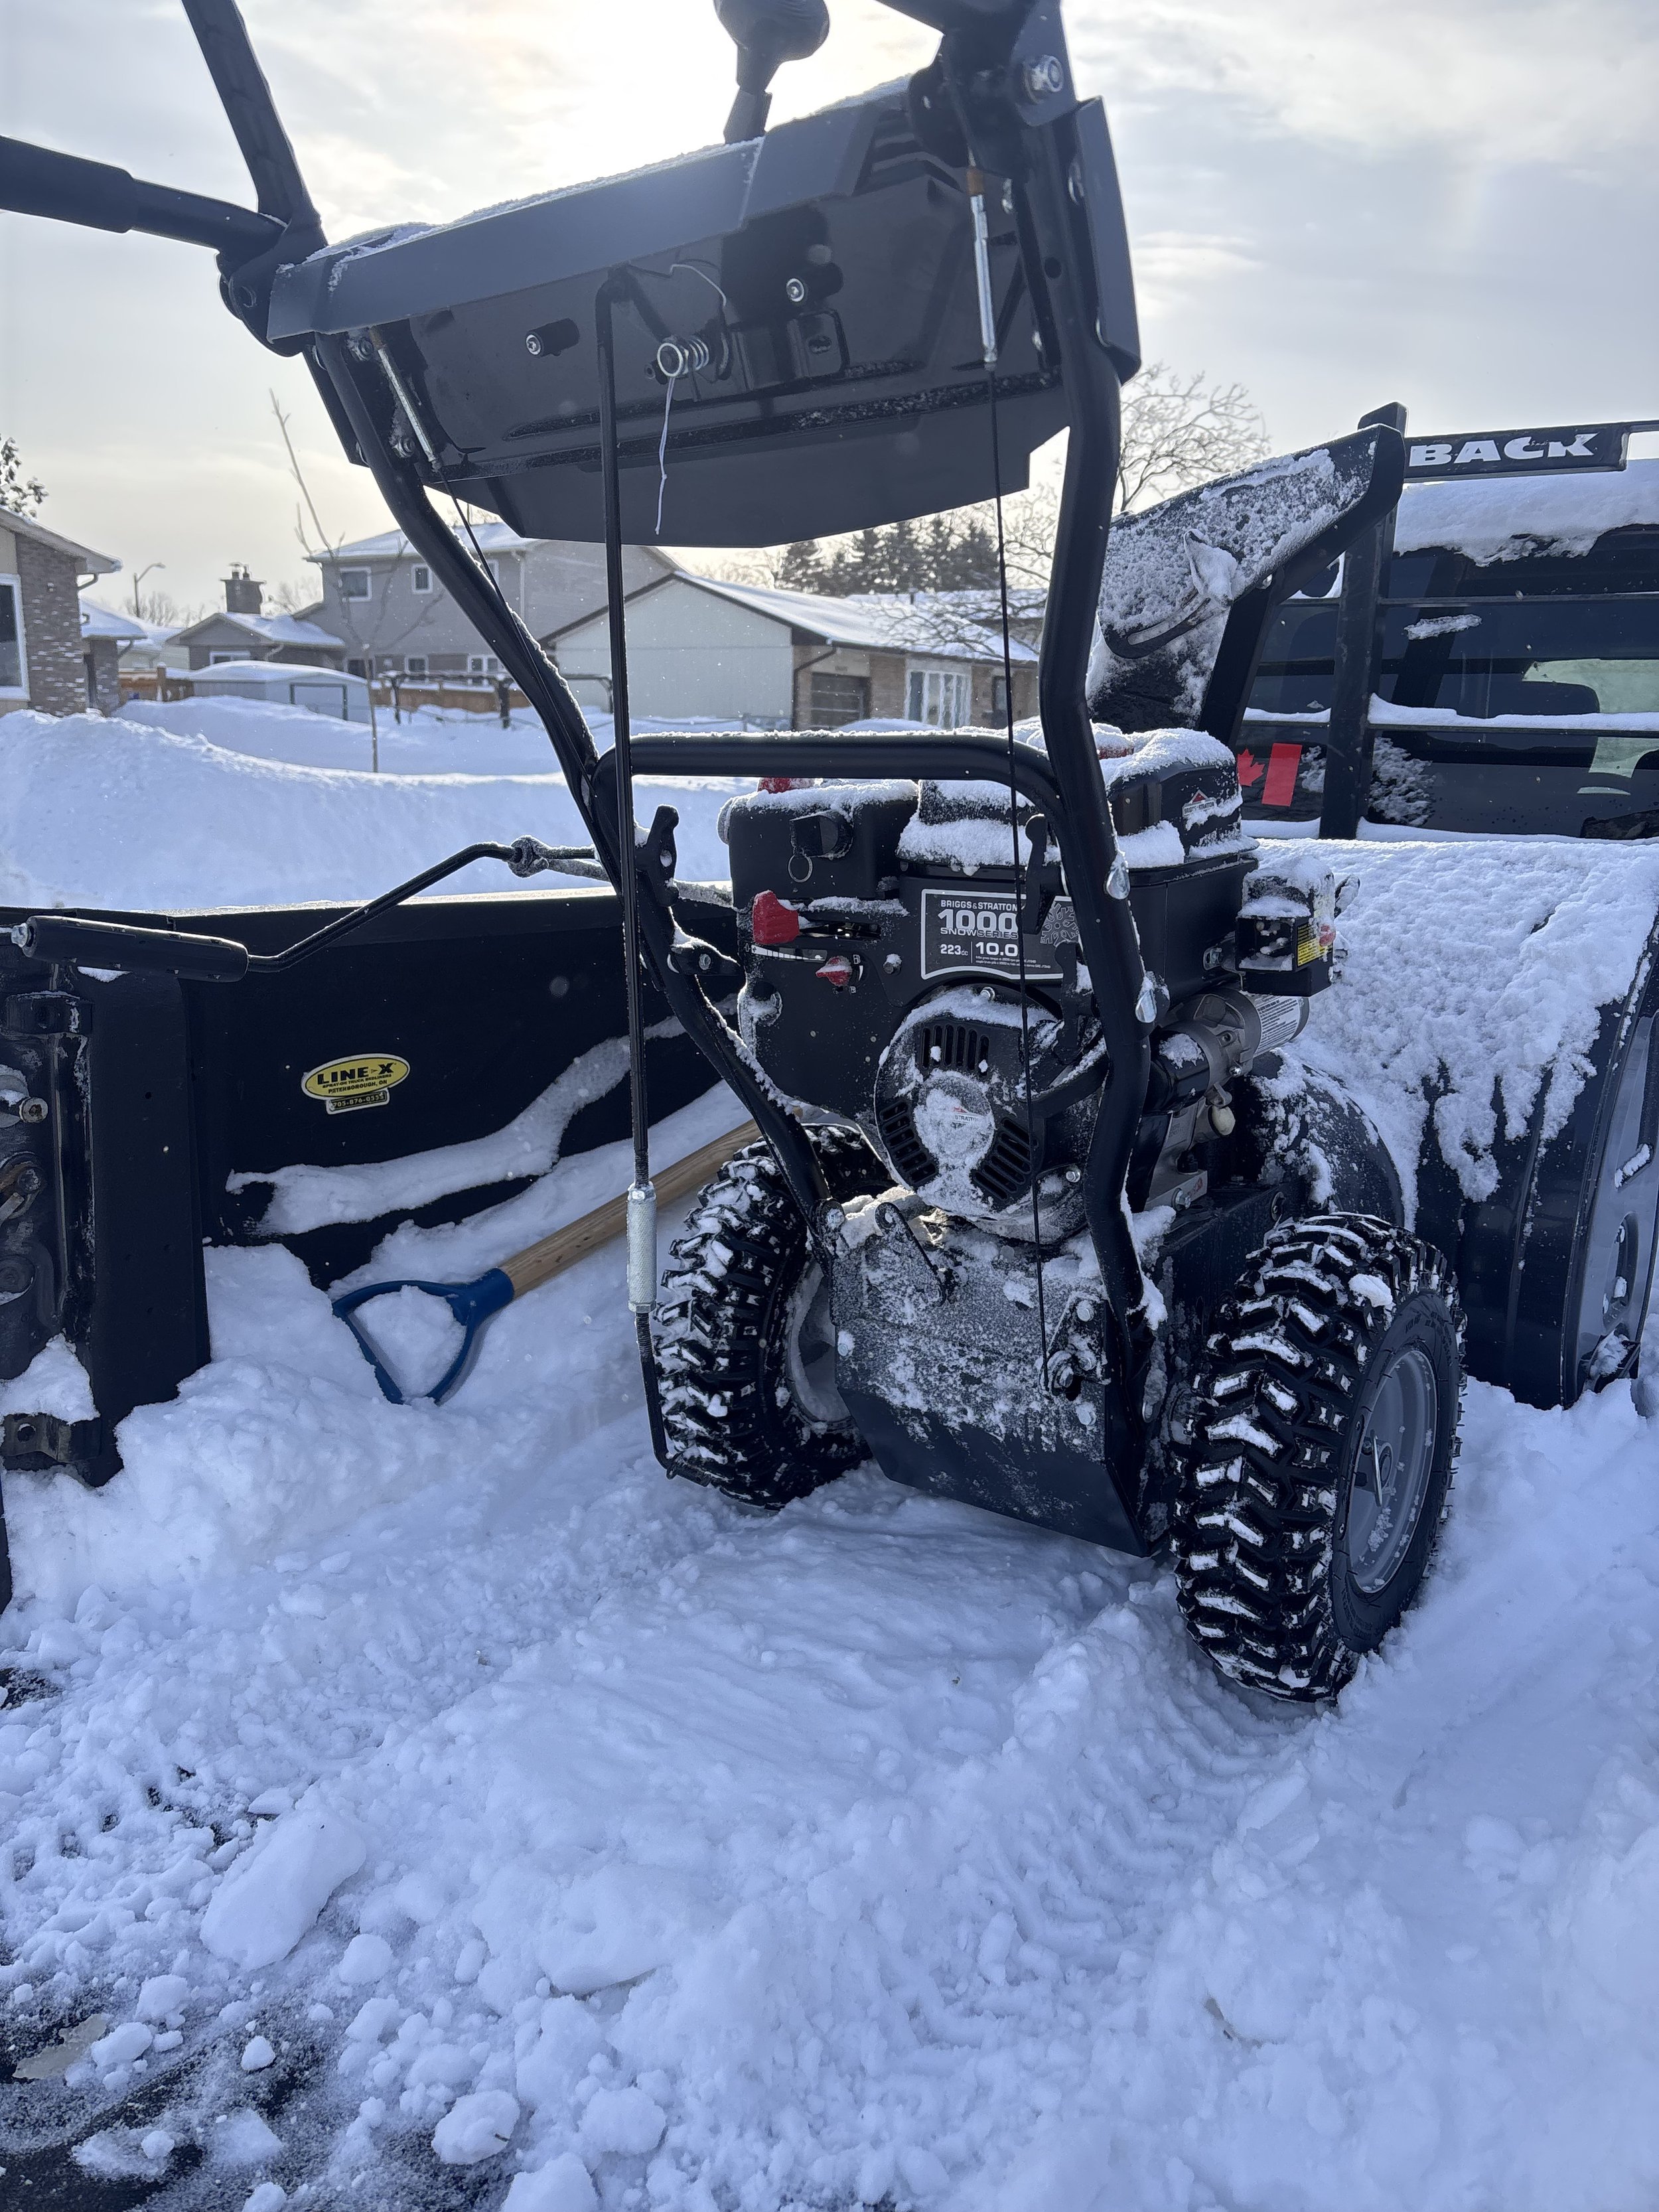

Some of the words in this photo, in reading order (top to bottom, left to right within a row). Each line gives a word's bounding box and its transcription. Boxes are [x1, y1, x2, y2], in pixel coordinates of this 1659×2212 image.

[1409, 432, 1600, 467] BACK
[938, 909, 1018, 932] 1000
[975, 942, 1019, 956] 10.0
[317, 1063, 394, 1084] LINE-X
